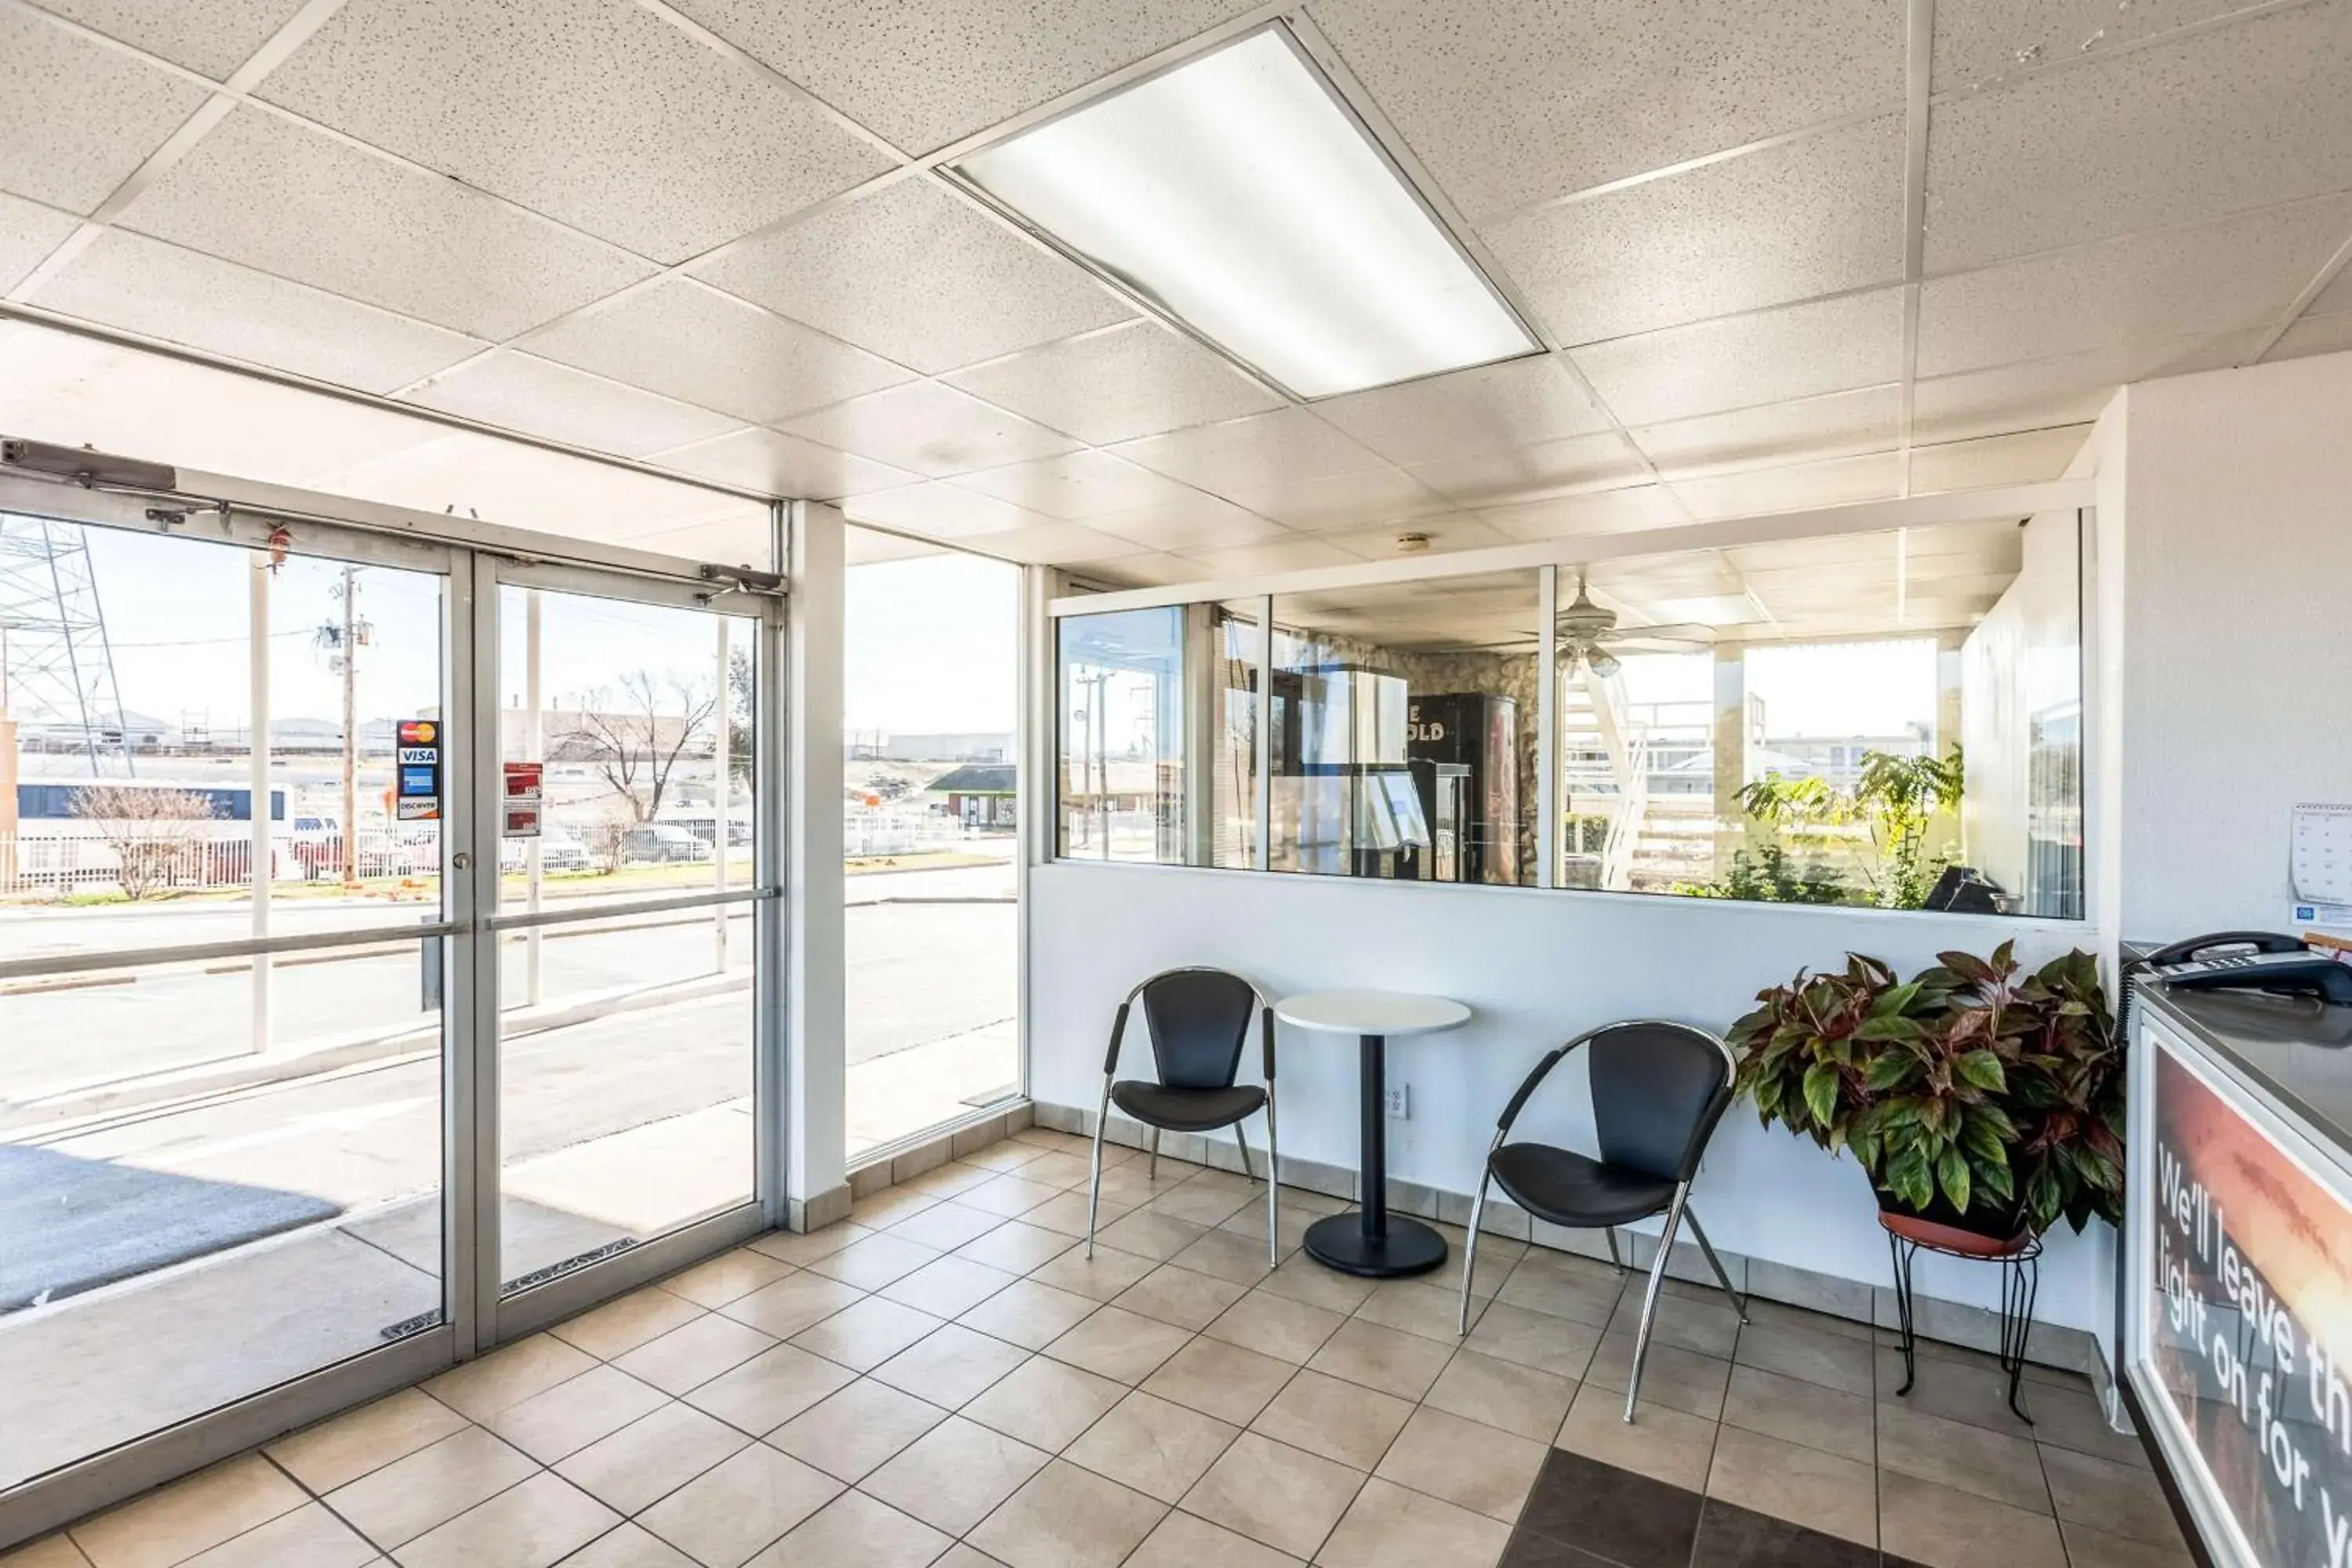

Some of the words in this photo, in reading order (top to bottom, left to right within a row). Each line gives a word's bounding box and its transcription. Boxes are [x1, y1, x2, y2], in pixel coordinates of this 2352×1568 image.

[403, 750, 435, 761] VISA
[2158, 1140, 2209, 1264] We'll
[2217, 1206, 2295, 1374] leave
[2159, 1223, 2207, 1359] light
[2212, 1332, 2248, 1425] on
[2256, 1371, 2310, 1512] for
[2319, 1486, 2352, 1568] y
